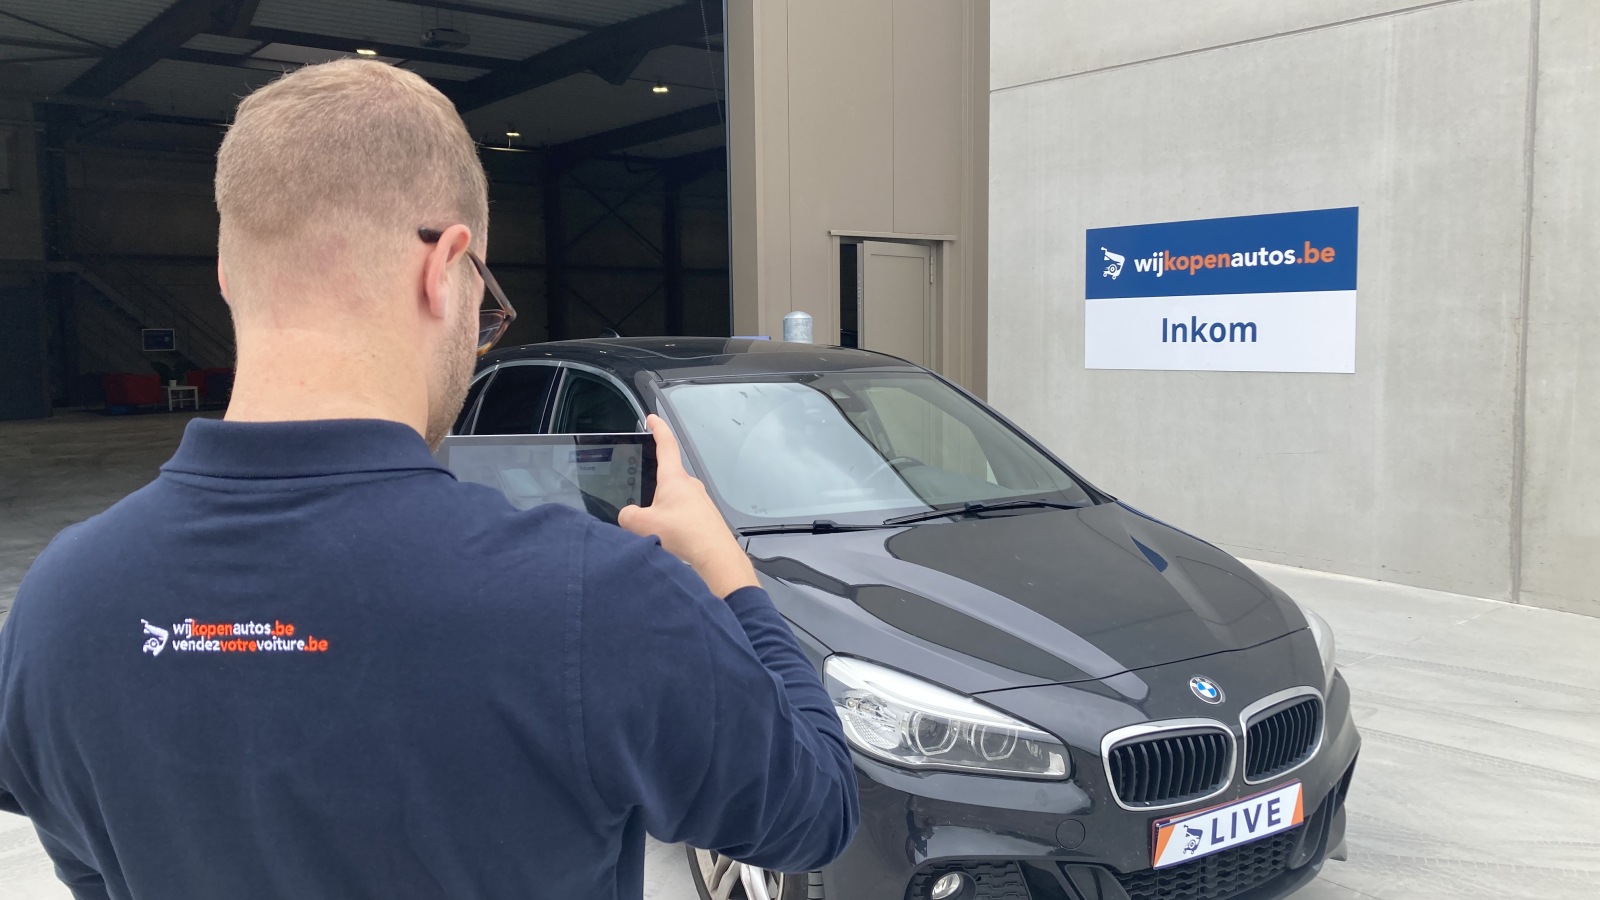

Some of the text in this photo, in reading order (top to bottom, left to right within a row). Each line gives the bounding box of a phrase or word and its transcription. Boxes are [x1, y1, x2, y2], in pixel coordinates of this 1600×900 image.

[1134, 241, 1336, 277] wijkopenautos.be
[1162, 316, 1257, 343] Inkom
[172, 618, 294, 639] wijkopenautos.be
[172, 635, 328, 652] vendezvotrevoiture.be
[1210, 797, 1281, 845] LIVE
